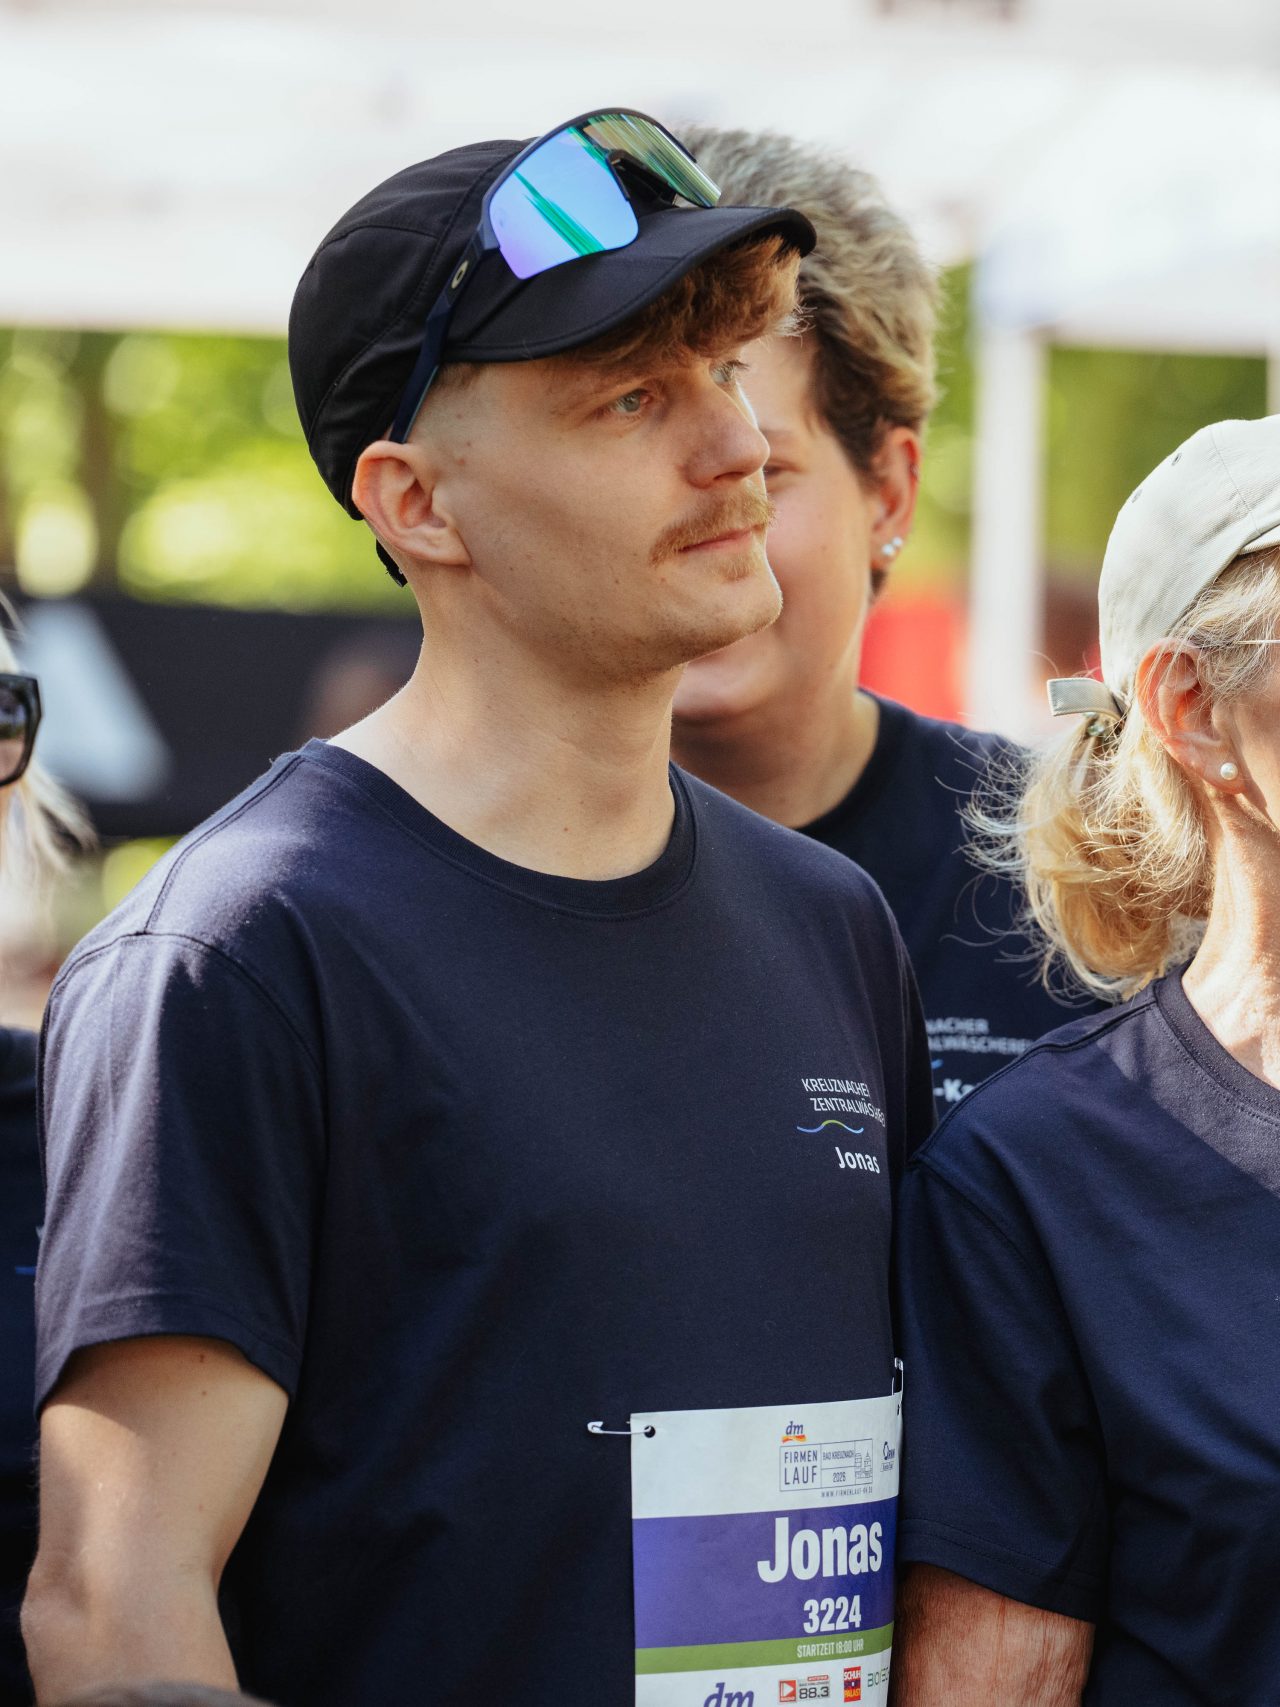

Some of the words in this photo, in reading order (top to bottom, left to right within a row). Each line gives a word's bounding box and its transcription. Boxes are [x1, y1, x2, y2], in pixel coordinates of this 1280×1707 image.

[835, 1146, 880, 1174] Jonas
[785, 1420, 804, 1435] dm
[784, 1450, 818, 1463] FIRMEN
[784, 1465, 818, 1485] LAUF
[756, 1516, 883, 1584] Jonas
[803, 1594, 862, 1634] 3224
[796, 1642, 835, 1658] STARTZEIT
[703, 1682, 755, 1707] dm
[799, 1686, 830, 1700] 88.3
